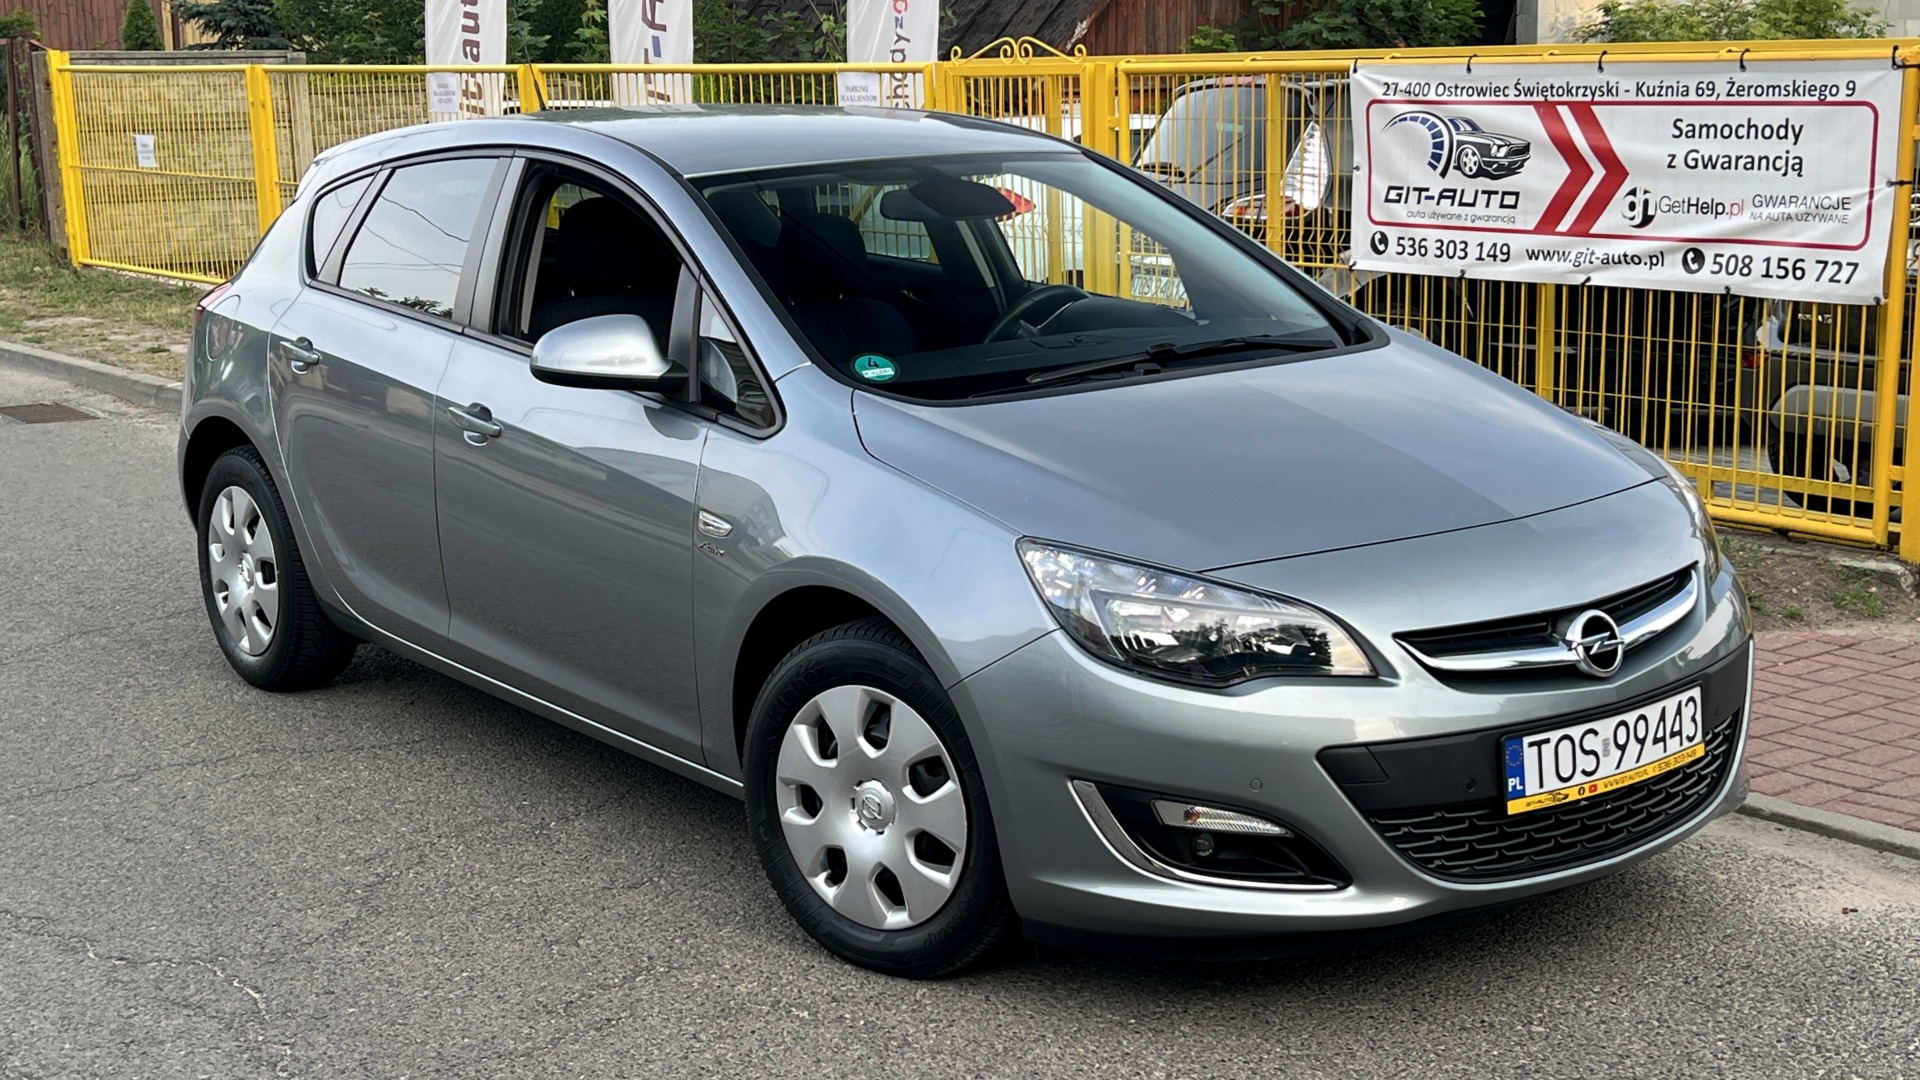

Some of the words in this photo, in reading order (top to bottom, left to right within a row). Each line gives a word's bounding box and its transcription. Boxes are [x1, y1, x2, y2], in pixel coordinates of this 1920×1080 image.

[1382, 81, 1431, 98] 27-400
[1434, 81, 1510, 98] Ostrowiec
[1513, 78, 1620, 101] Świętokrzyski
[1635, 80, 1690, 98] Kuźnia
[1695, 81, 1721, 100] 69,
[1726, 77, 1840, 101] Żeromskiego
[1845, 80, 1857, 98] 9
[1671, 117, 1804, 145] Samochody
[1667, 153, 1677, 169] z
[1684, 149, 1804, 177] Gwarancją
[1384, 185, 1521, 210] GIT-AUTO
[1658, 195, 1744, 220] GetHelp.pl
[1752, 194, 1852, 211] GWARANCJE
[1406, 210, 1426, 219] auta
[1749, 211, 1763, 221] NA
[1765, 212, 1794, 222] AUTA
[1796, 211, 1849, 224] UŻYWANE
[1395, 236, 1428, 257] 536
[1434, 239, 1469, 260] 303
[1475, 241, 1512, 263] 149
[1526, 247, 1665, 271] www.git-auto.pl
[1710, 253, 1754, 277] 508
[1761, 256, 1806, 281] 156
[1814, 259, 1859, 285] 727
[1528, 727, 1601, 790] TOS
[1612, 694, 1699, 771] 99443
[1508, 776, 1524, 791] PL
